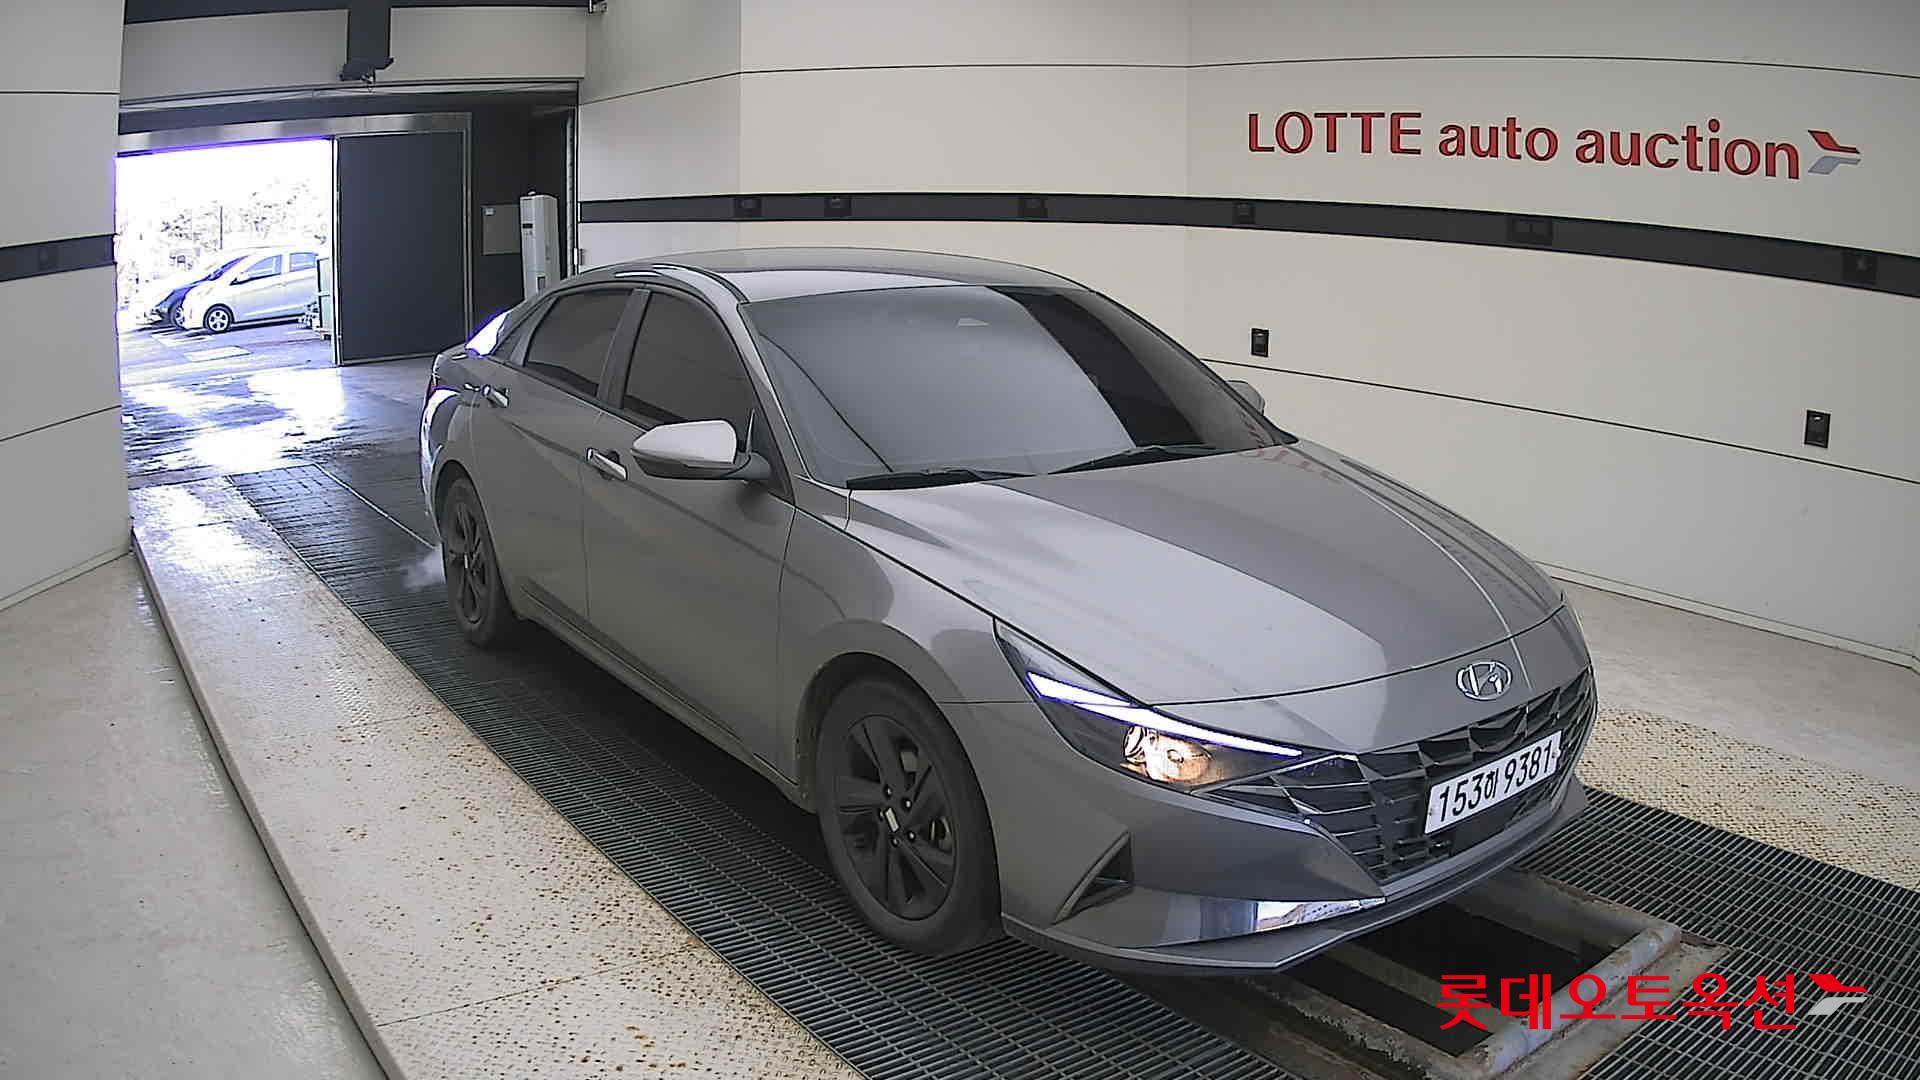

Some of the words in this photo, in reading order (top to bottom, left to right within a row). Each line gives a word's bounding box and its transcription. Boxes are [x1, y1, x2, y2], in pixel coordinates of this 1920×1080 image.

[1248, 111, 1422, 155] LOTTE
[1438, 116, 1559, 162] auto
[1575, 118, 1800, 180] auction
[1504, 740, 1552, 794] 9381
